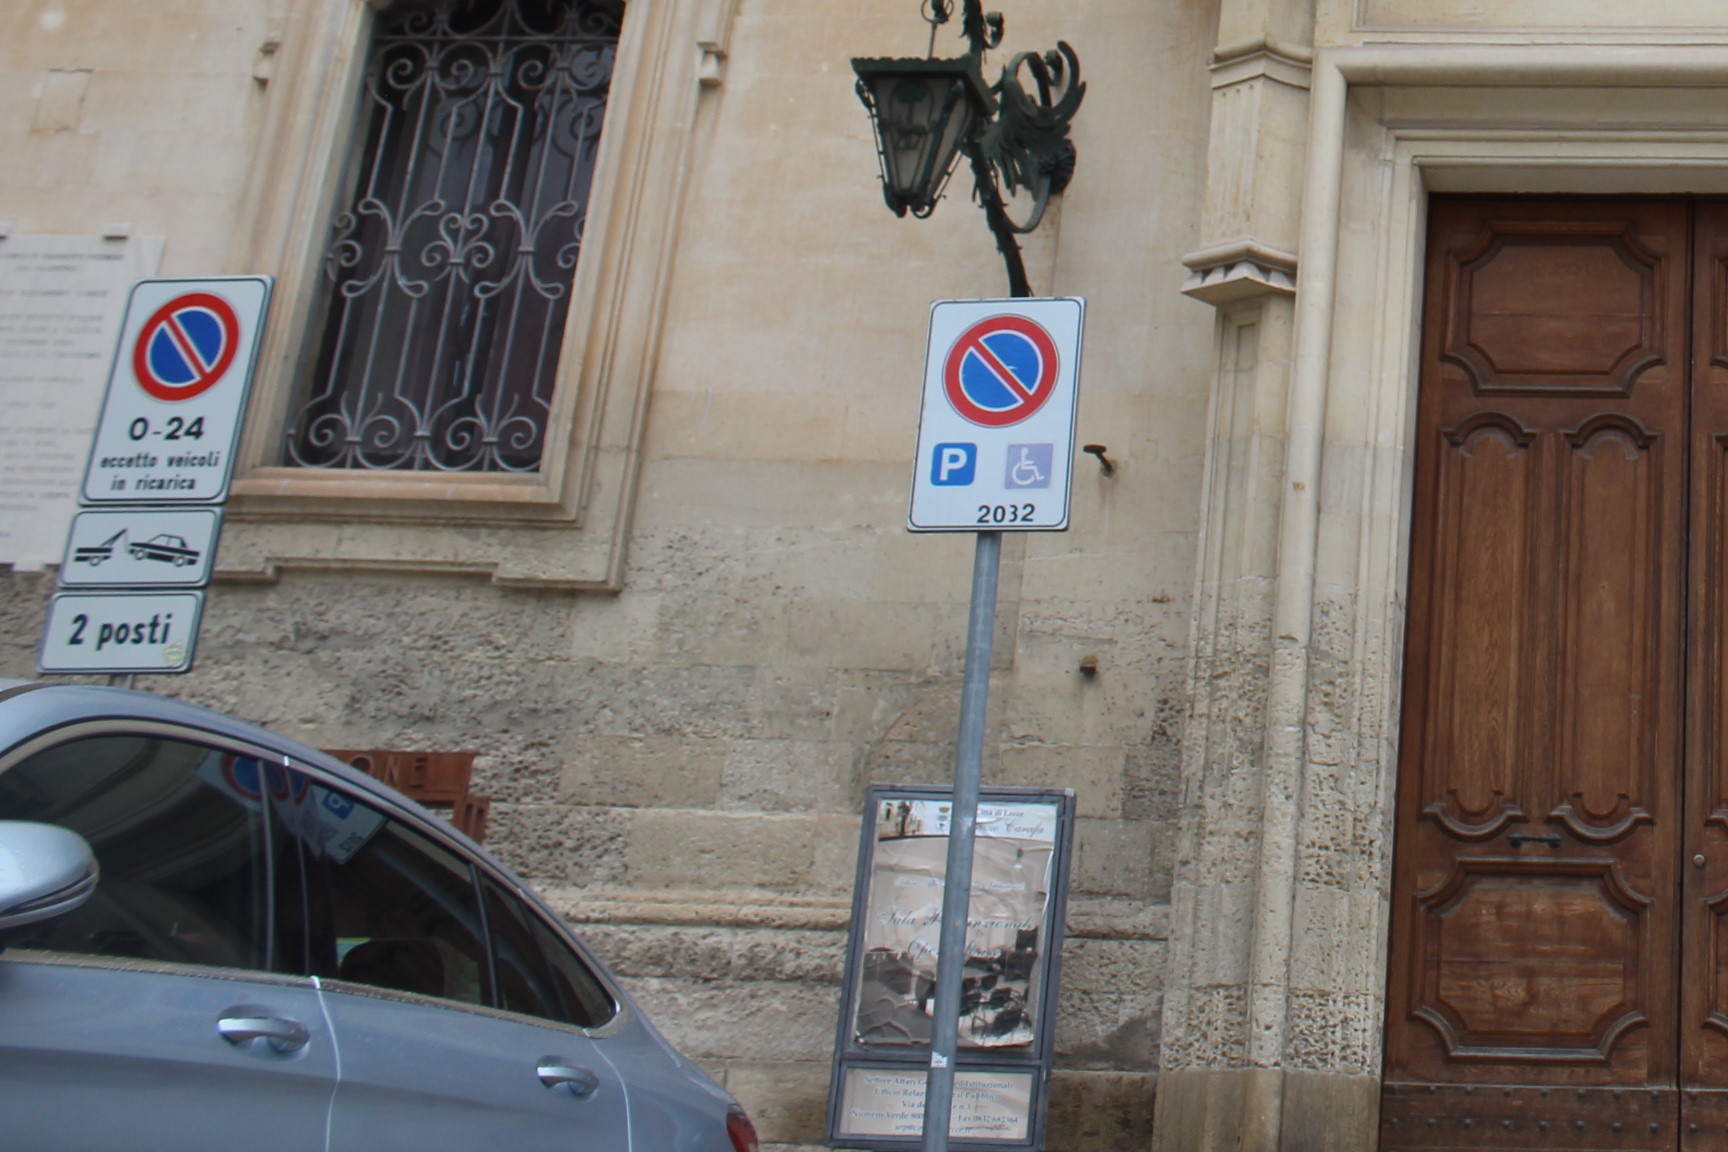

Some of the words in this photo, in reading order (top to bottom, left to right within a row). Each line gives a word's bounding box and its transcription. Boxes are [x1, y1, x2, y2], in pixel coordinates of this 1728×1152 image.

[100, 452, 158, 469] eccetto
[167, 450, 220, 468] veicoli
[939, 448, 967, 481] P
[111, 475, 128, 491] in
[135, 474, 196, 491] ricarica
[977, 503, 1036, 524] 2032
[68, 614, 88, 645] 2
[97, 613, 173, 649] posti
[1004, 809, 1025, 818] Lecce
